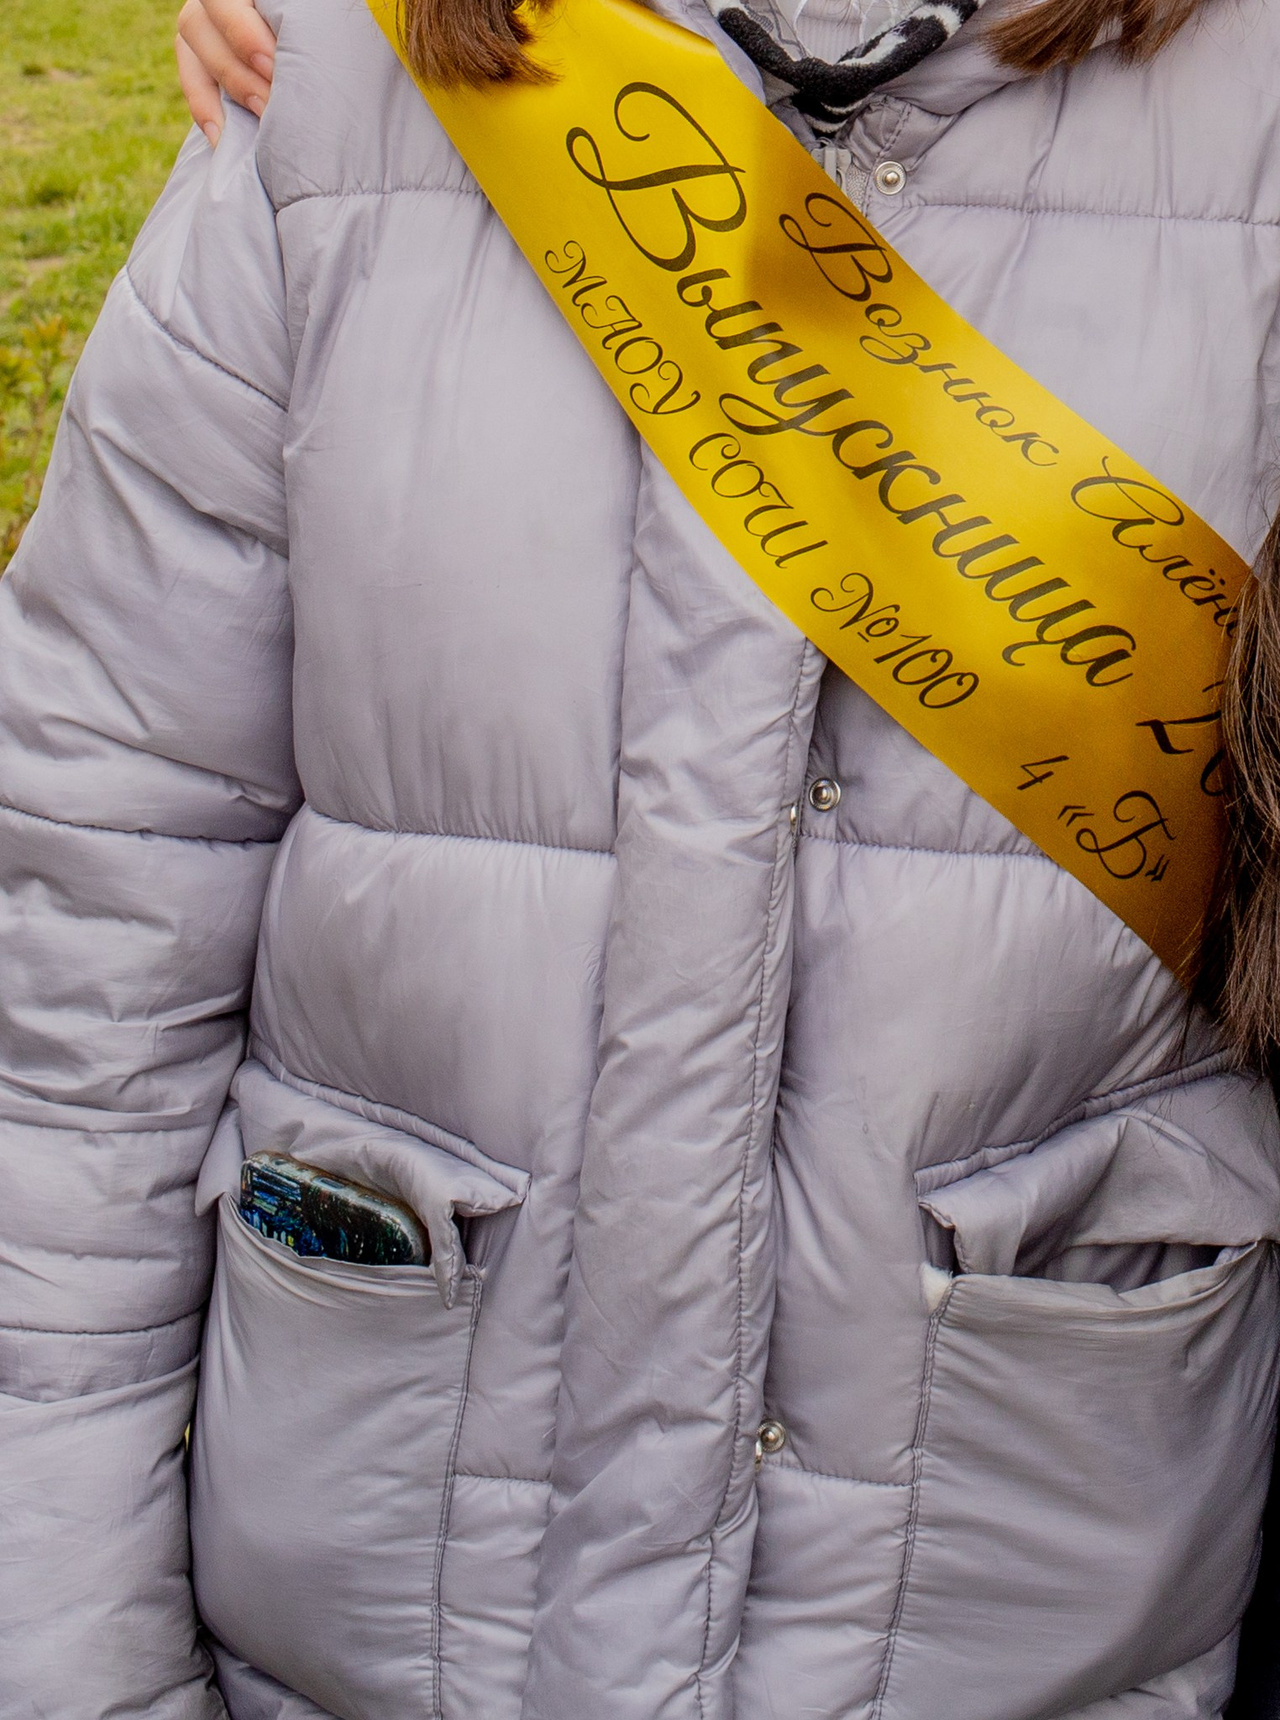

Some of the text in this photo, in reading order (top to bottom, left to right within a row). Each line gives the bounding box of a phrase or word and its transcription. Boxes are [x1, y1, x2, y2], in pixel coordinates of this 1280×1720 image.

[544, 240, 700, 414] МАОУ
[688, 432, 828, 569] СОШ
[810, 572, 979, 709] №100
[1016, 755, 1070, 791] 4
[566, 81, 1137, 687] Выпускница
[778, 192, 1240, 638] Вознюк Алён
